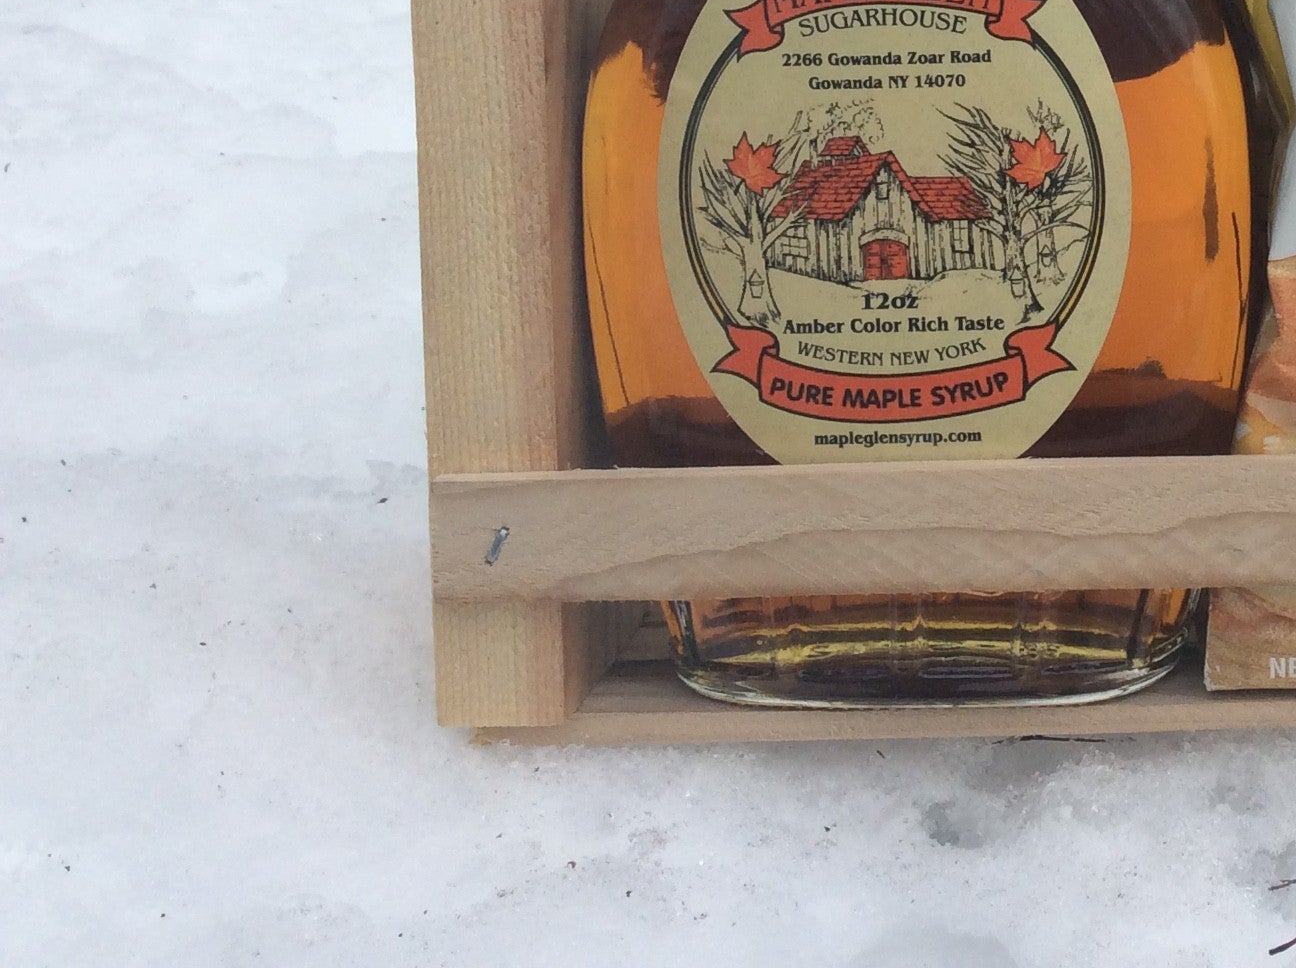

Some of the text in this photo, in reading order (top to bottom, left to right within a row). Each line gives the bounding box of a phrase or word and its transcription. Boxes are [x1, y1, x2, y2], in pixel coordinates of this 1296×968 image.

[798, 7, 968, 38] SUGARHOUSE
[782, 49, 992, 67] 2266 Gowanda Zoar Road
[808, 74, 966, 90] Gowanda NY 14070
[861, 293, 919, 310] 12oz
[783, 316, 1005, 335] Amber Color Rich Taste
[798, 338, 986, 366] WESTERN NEW YORK
[769, 372, 1009, 409] PURE MAPLE SYRUP
[814, 430, 982, 448] mapleglensyrup.com
